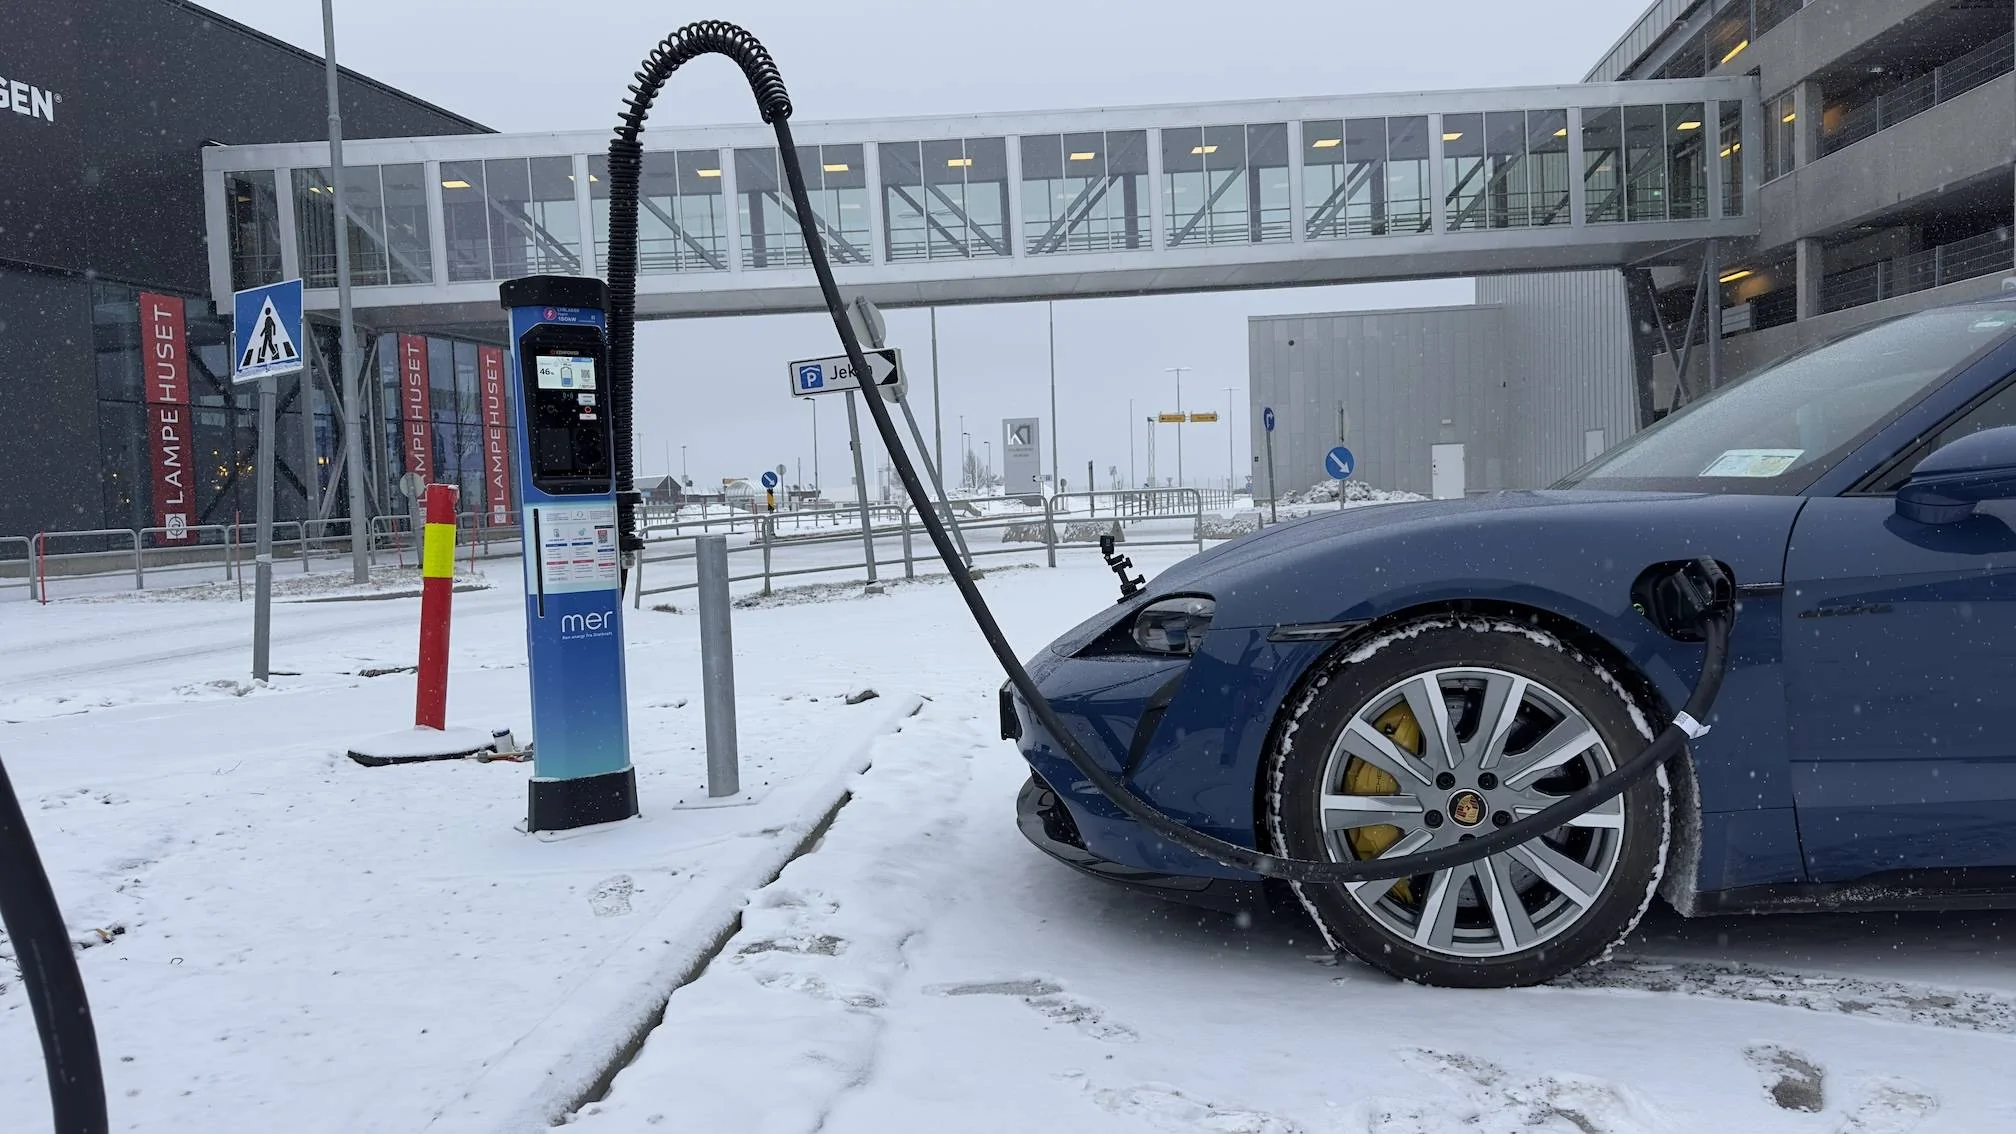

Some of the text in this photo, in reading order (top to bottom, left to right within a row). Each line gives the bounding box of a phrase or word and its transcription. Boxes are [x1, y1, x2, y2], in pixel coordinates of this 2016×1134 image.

[154, 304, 184, 504] LAMPEHUSET
[486, 355, 505, 501] LAMPEHUSET
[561, 611, 613, 633] mer
